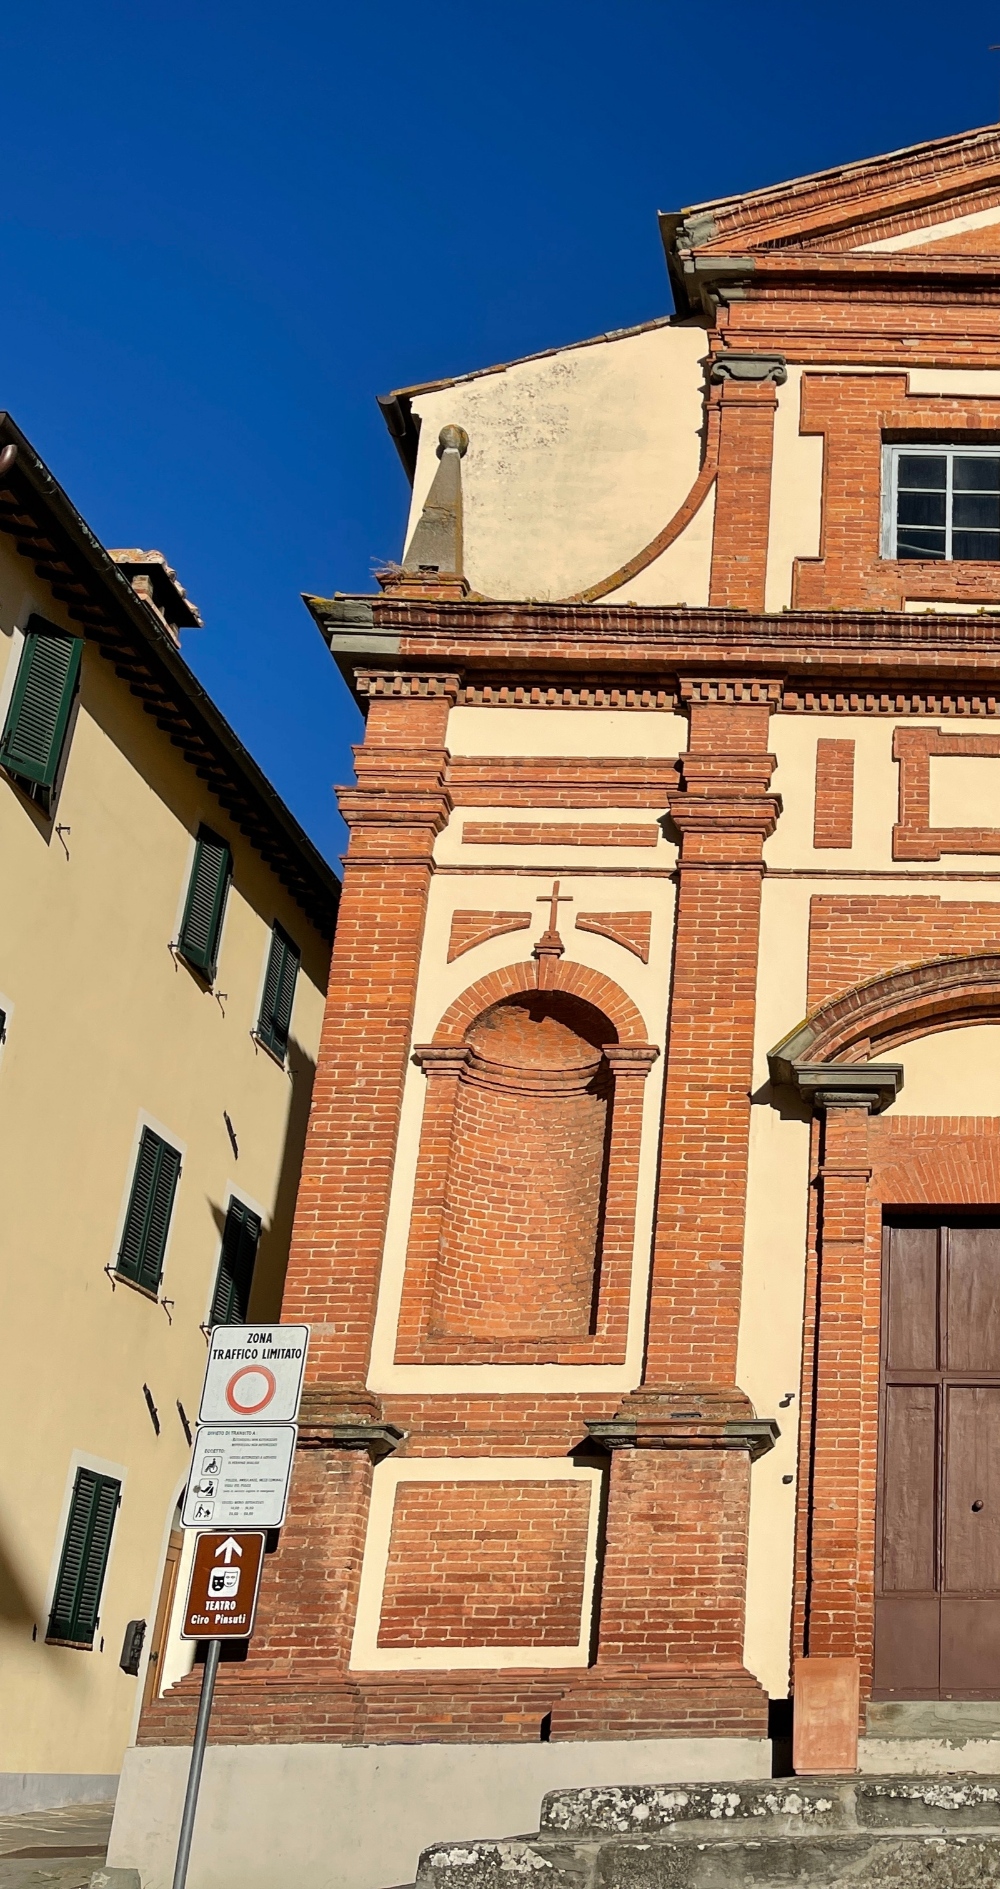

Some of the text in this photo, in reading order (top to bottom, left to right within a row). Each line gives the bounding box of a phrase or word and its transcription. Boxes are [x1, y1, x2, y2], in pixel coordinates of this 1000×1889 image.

[247, 1333, 272, 1343] ZONA
[213, 1348, 302, 1360] TRAFFICO LIMITATO
[205, 1601, 236, 1610] TEATRO
[191, 1614, 246, 1624] Ciro Pinsuti
